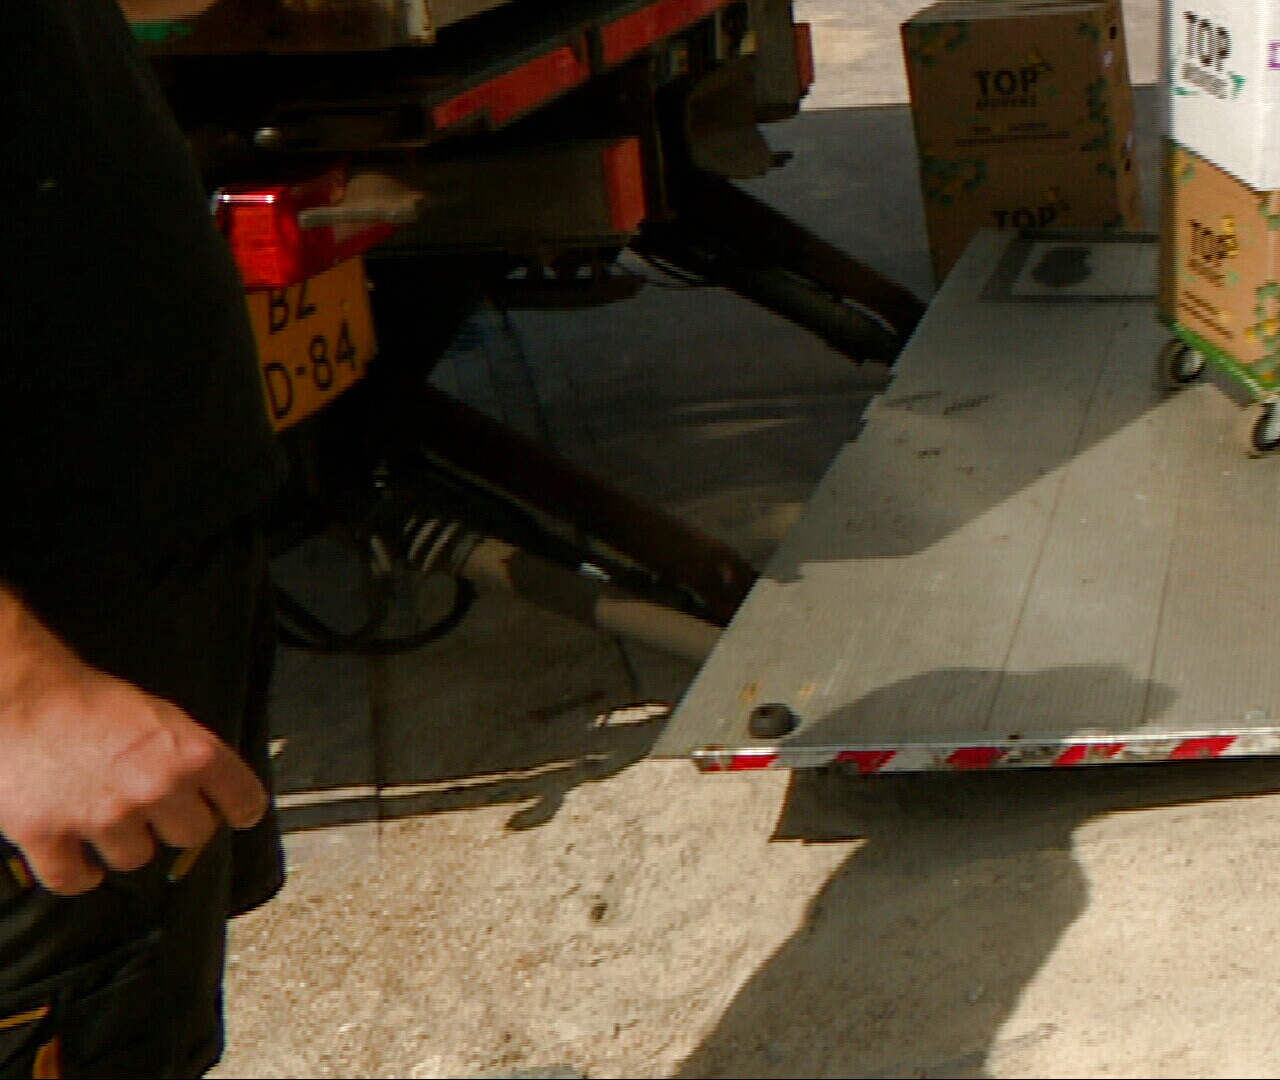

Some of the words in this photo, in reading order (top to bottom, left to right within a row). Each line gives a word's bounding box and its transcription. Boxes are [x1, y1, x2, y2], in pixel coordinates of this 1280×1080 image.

[1184, 11, 1230, 72] TOP
[973, 67, 1039, 96] TOP
[1188, 219, 1228, 263] TOP
